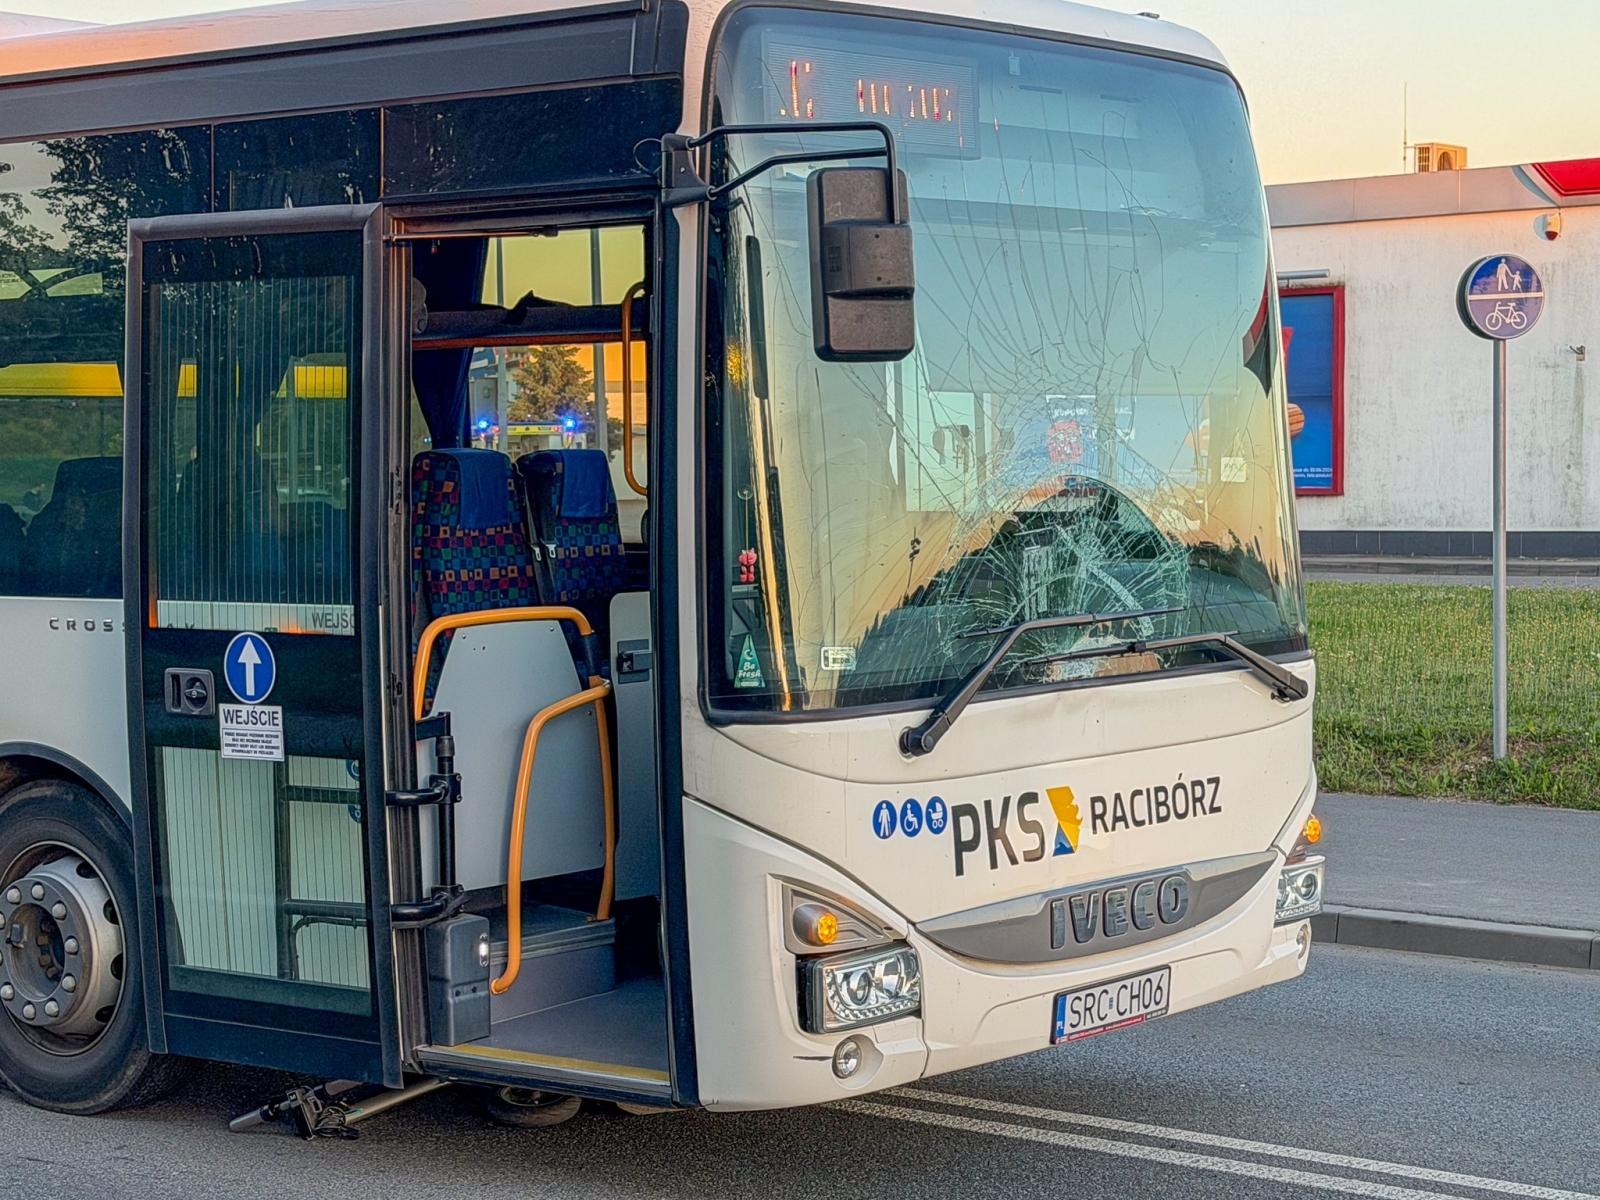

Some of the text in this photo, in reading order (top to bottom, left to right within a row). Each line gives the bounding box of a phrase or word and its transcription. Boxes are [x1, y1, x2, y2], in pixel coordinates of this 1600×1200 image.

[49, 617, 125, 632] CROS
[223, 706, 279, 727] WEJŚCIE
[951, 773, 1222, 877] PKS RACIBÓRZ
[1050, 876, 1190, 950] IVECO
[1069, 988, 1109, 1029] SRC
[1116, 974, 1164, 1016] CH06
